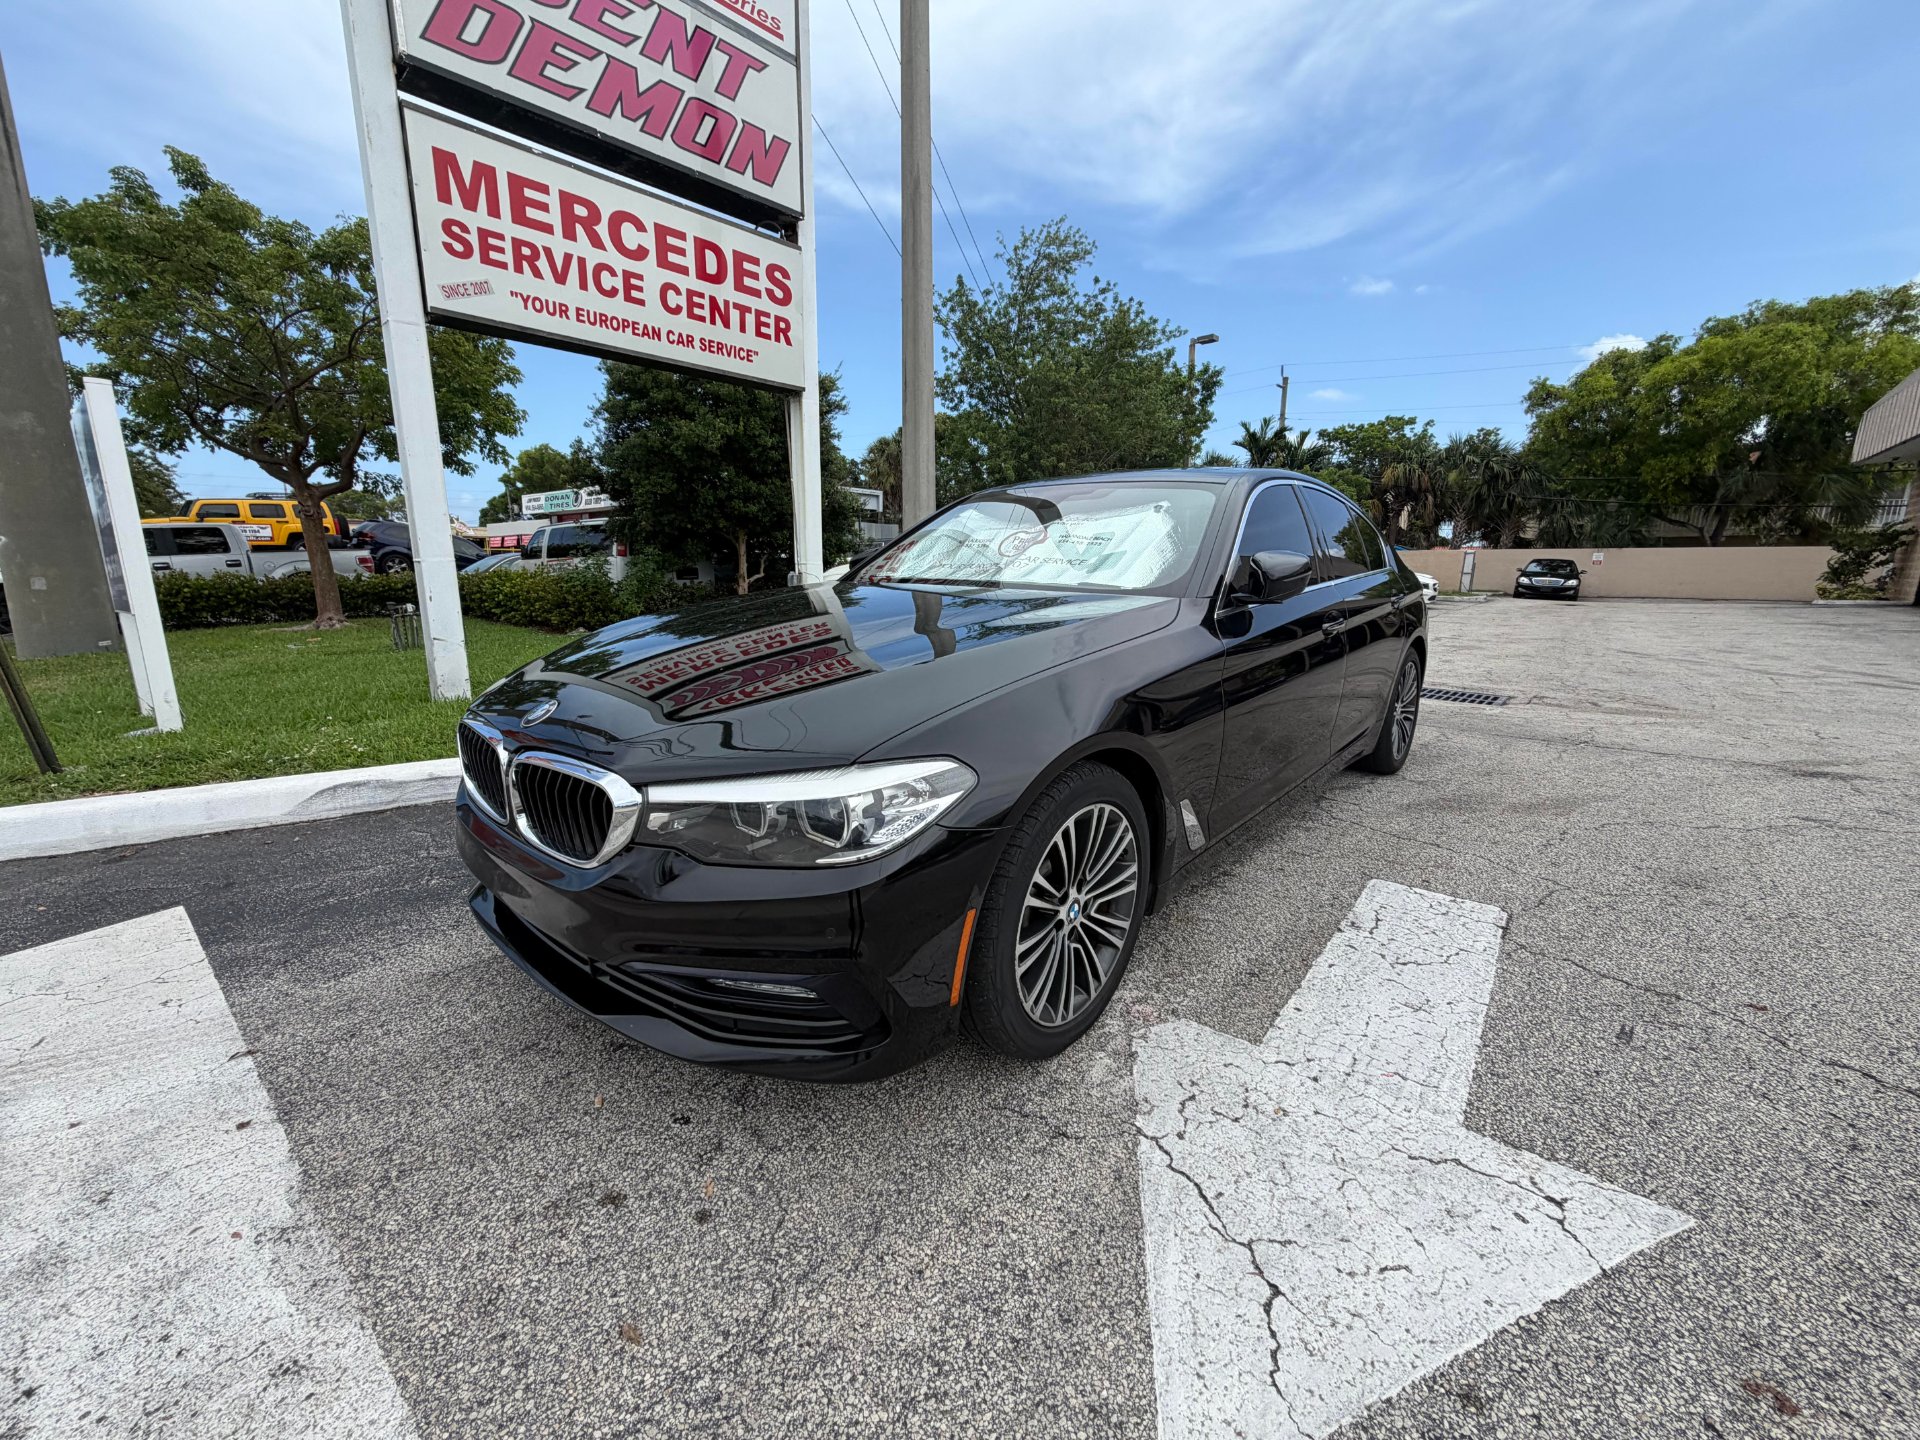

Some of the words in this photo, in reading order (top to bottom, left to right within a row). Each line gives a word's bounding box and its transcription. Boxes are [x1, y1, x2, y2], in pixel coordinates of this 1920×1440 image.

[419, 0, 792, 188] DEMON
[527, 0, 769, 102] ENT
[432, 146, 792, 307] MERCEDES
[441, 218, 646, 307] SERVICE
[659, 282, 793, 347] CENTER
[441, 283, 471, 299] SINCE
[470, 281, 491, 295] 2007
[510, 291, 570, 320] "YOUR
[575, 307, 661, 342] EUROPEAN
[666, 329, 695, 349] CAR
[699, 337, 759, 363] SERVICE"
[544, 494, 571, 502] DONAN
[549, 502, 570, 510] TIRES
